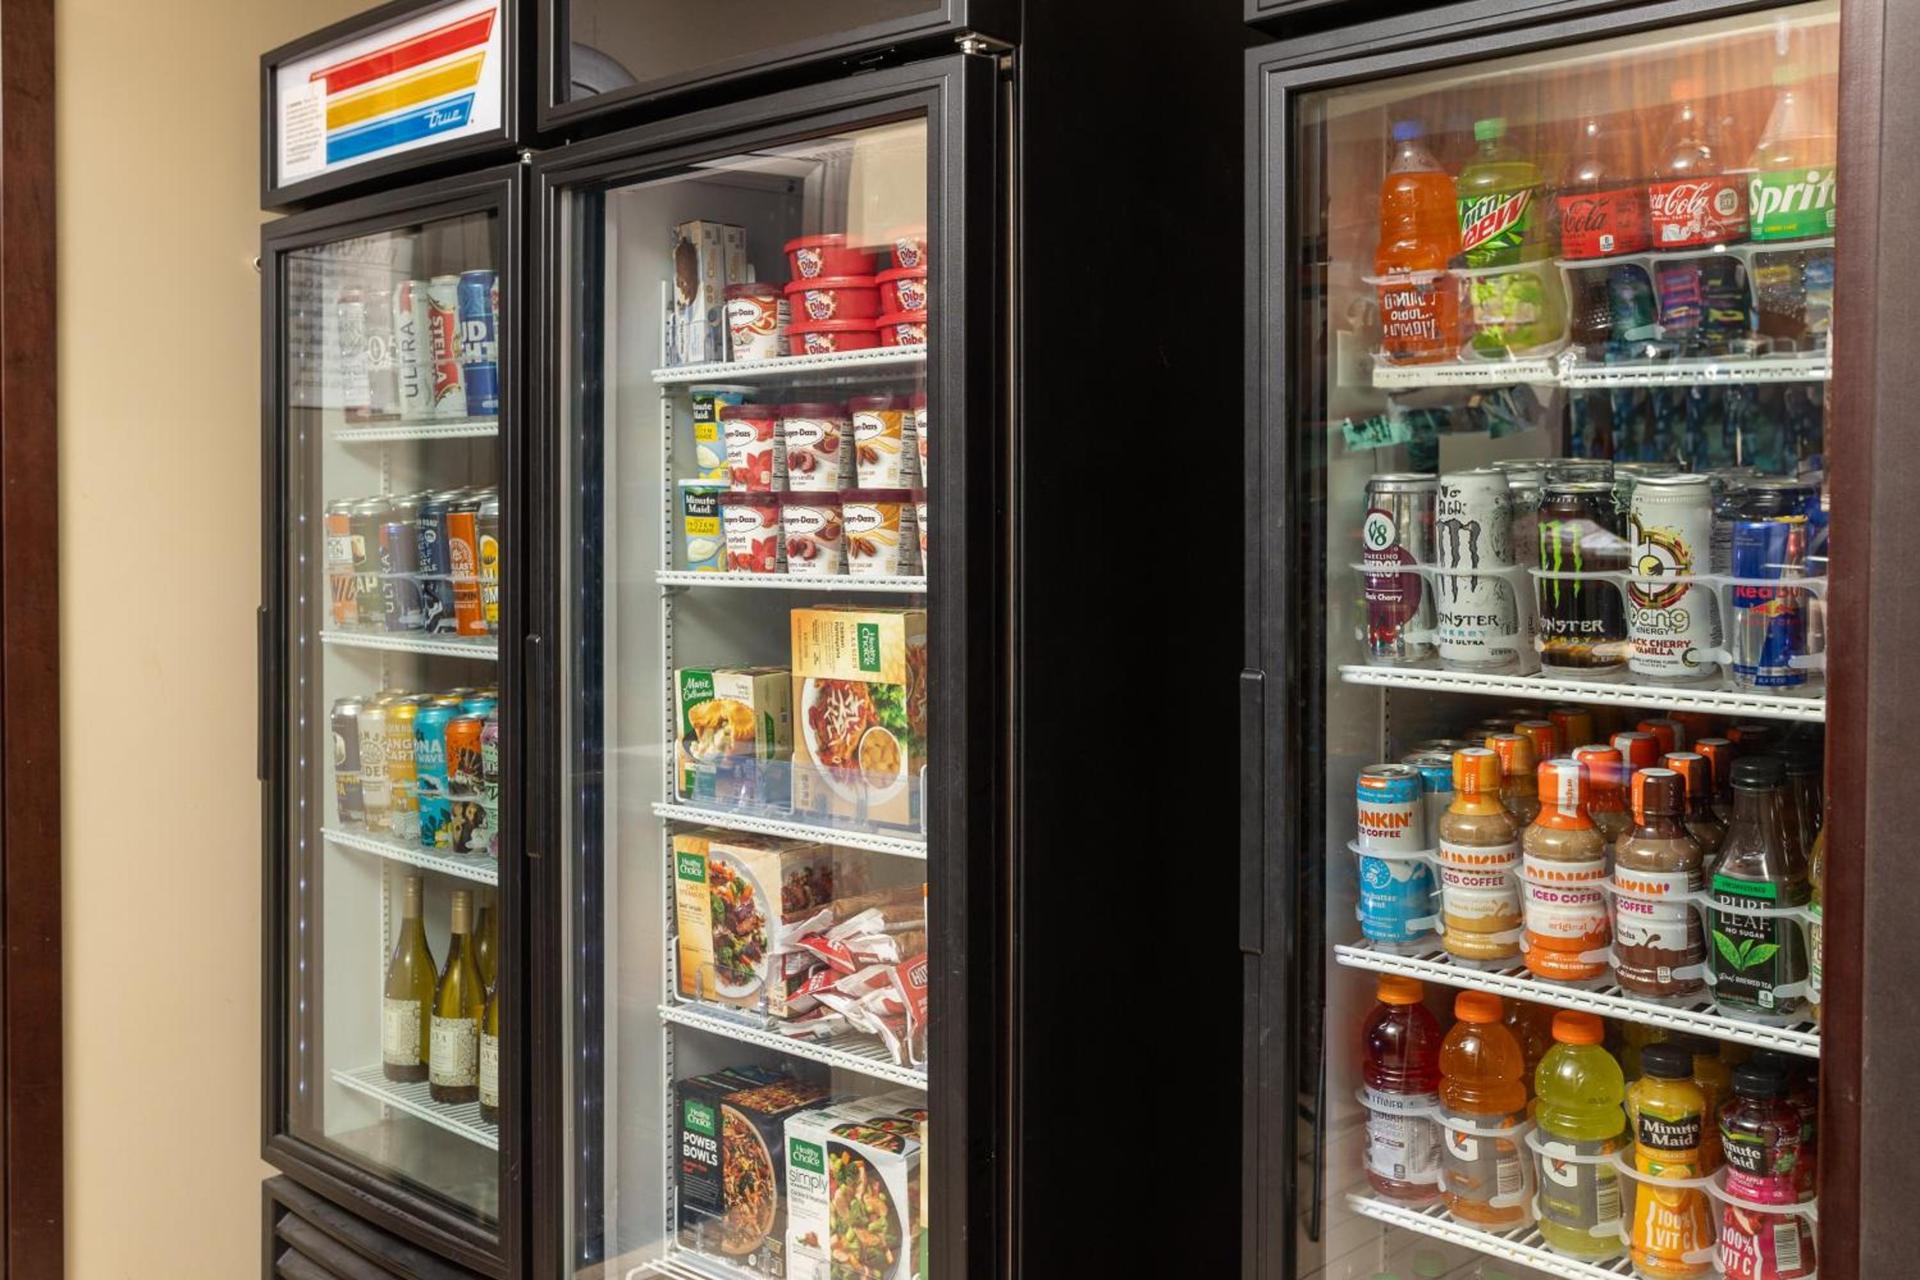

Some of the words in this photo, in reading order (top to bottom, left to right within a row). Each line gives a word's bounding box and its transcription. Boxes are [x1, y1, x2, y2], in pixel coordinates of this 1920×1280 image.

[425, 109, 463, 128] true
[900, 249, 918, 260] Dibs
[801, 259, 818, 271] Dibs
[902, 291, 925, 303] Dibs
[809, 300, 831, 312] Dibs
[901, 334, 924, 345] Dibs
[400, 321, 419, 399] ULTRA
[686, 495, 716, 505] Minute
[688, 504, 711, 513] Maid
[1368, 518, 1387, 546] V8
[1378, 592, 1402, 602] Cherry
[1636, 627, 1671, 635] ENERGY
[861, 627, 870, 666] Choice
[1635, 646, 1675, 656] VANILLA
[1649, 640, 1691, 649] CHERRY
[1366, 828, 1400, 838] COFFEE
[680, 866, 702, 877] Choice
[1462, 876, 1505, 887] COFFEE
[1532, 888, 1558, 902] ICED
[1620, 899, 1654, 914] COFFEE
[1720, 895, 1771, 911] PURE
[1720, 912, 1771, 931] LEAF
[1725, 927, 1737, 935] NO
[1739, 930, 1765, 940] SUGAR
[687, 1115, 711, 1128] Choice
[1644, 1119, 1698, 1134] Minute
[683, 1131, 717, 1153] POWER
[1652, 1133, 1693, 1146] Maid
[683, 1144, 718, 1167] BOWLS
[793, 1152, 820, 1166] Choice
[789, 1170, 828, 1195] simply
[1656, 1227, 1680, 1250] VIT
[1722, 1226, 1753, 1255] 100%
[1721, 1245, 1741, 1269] VIT
[1743, 1257, 1752, 1275] C
